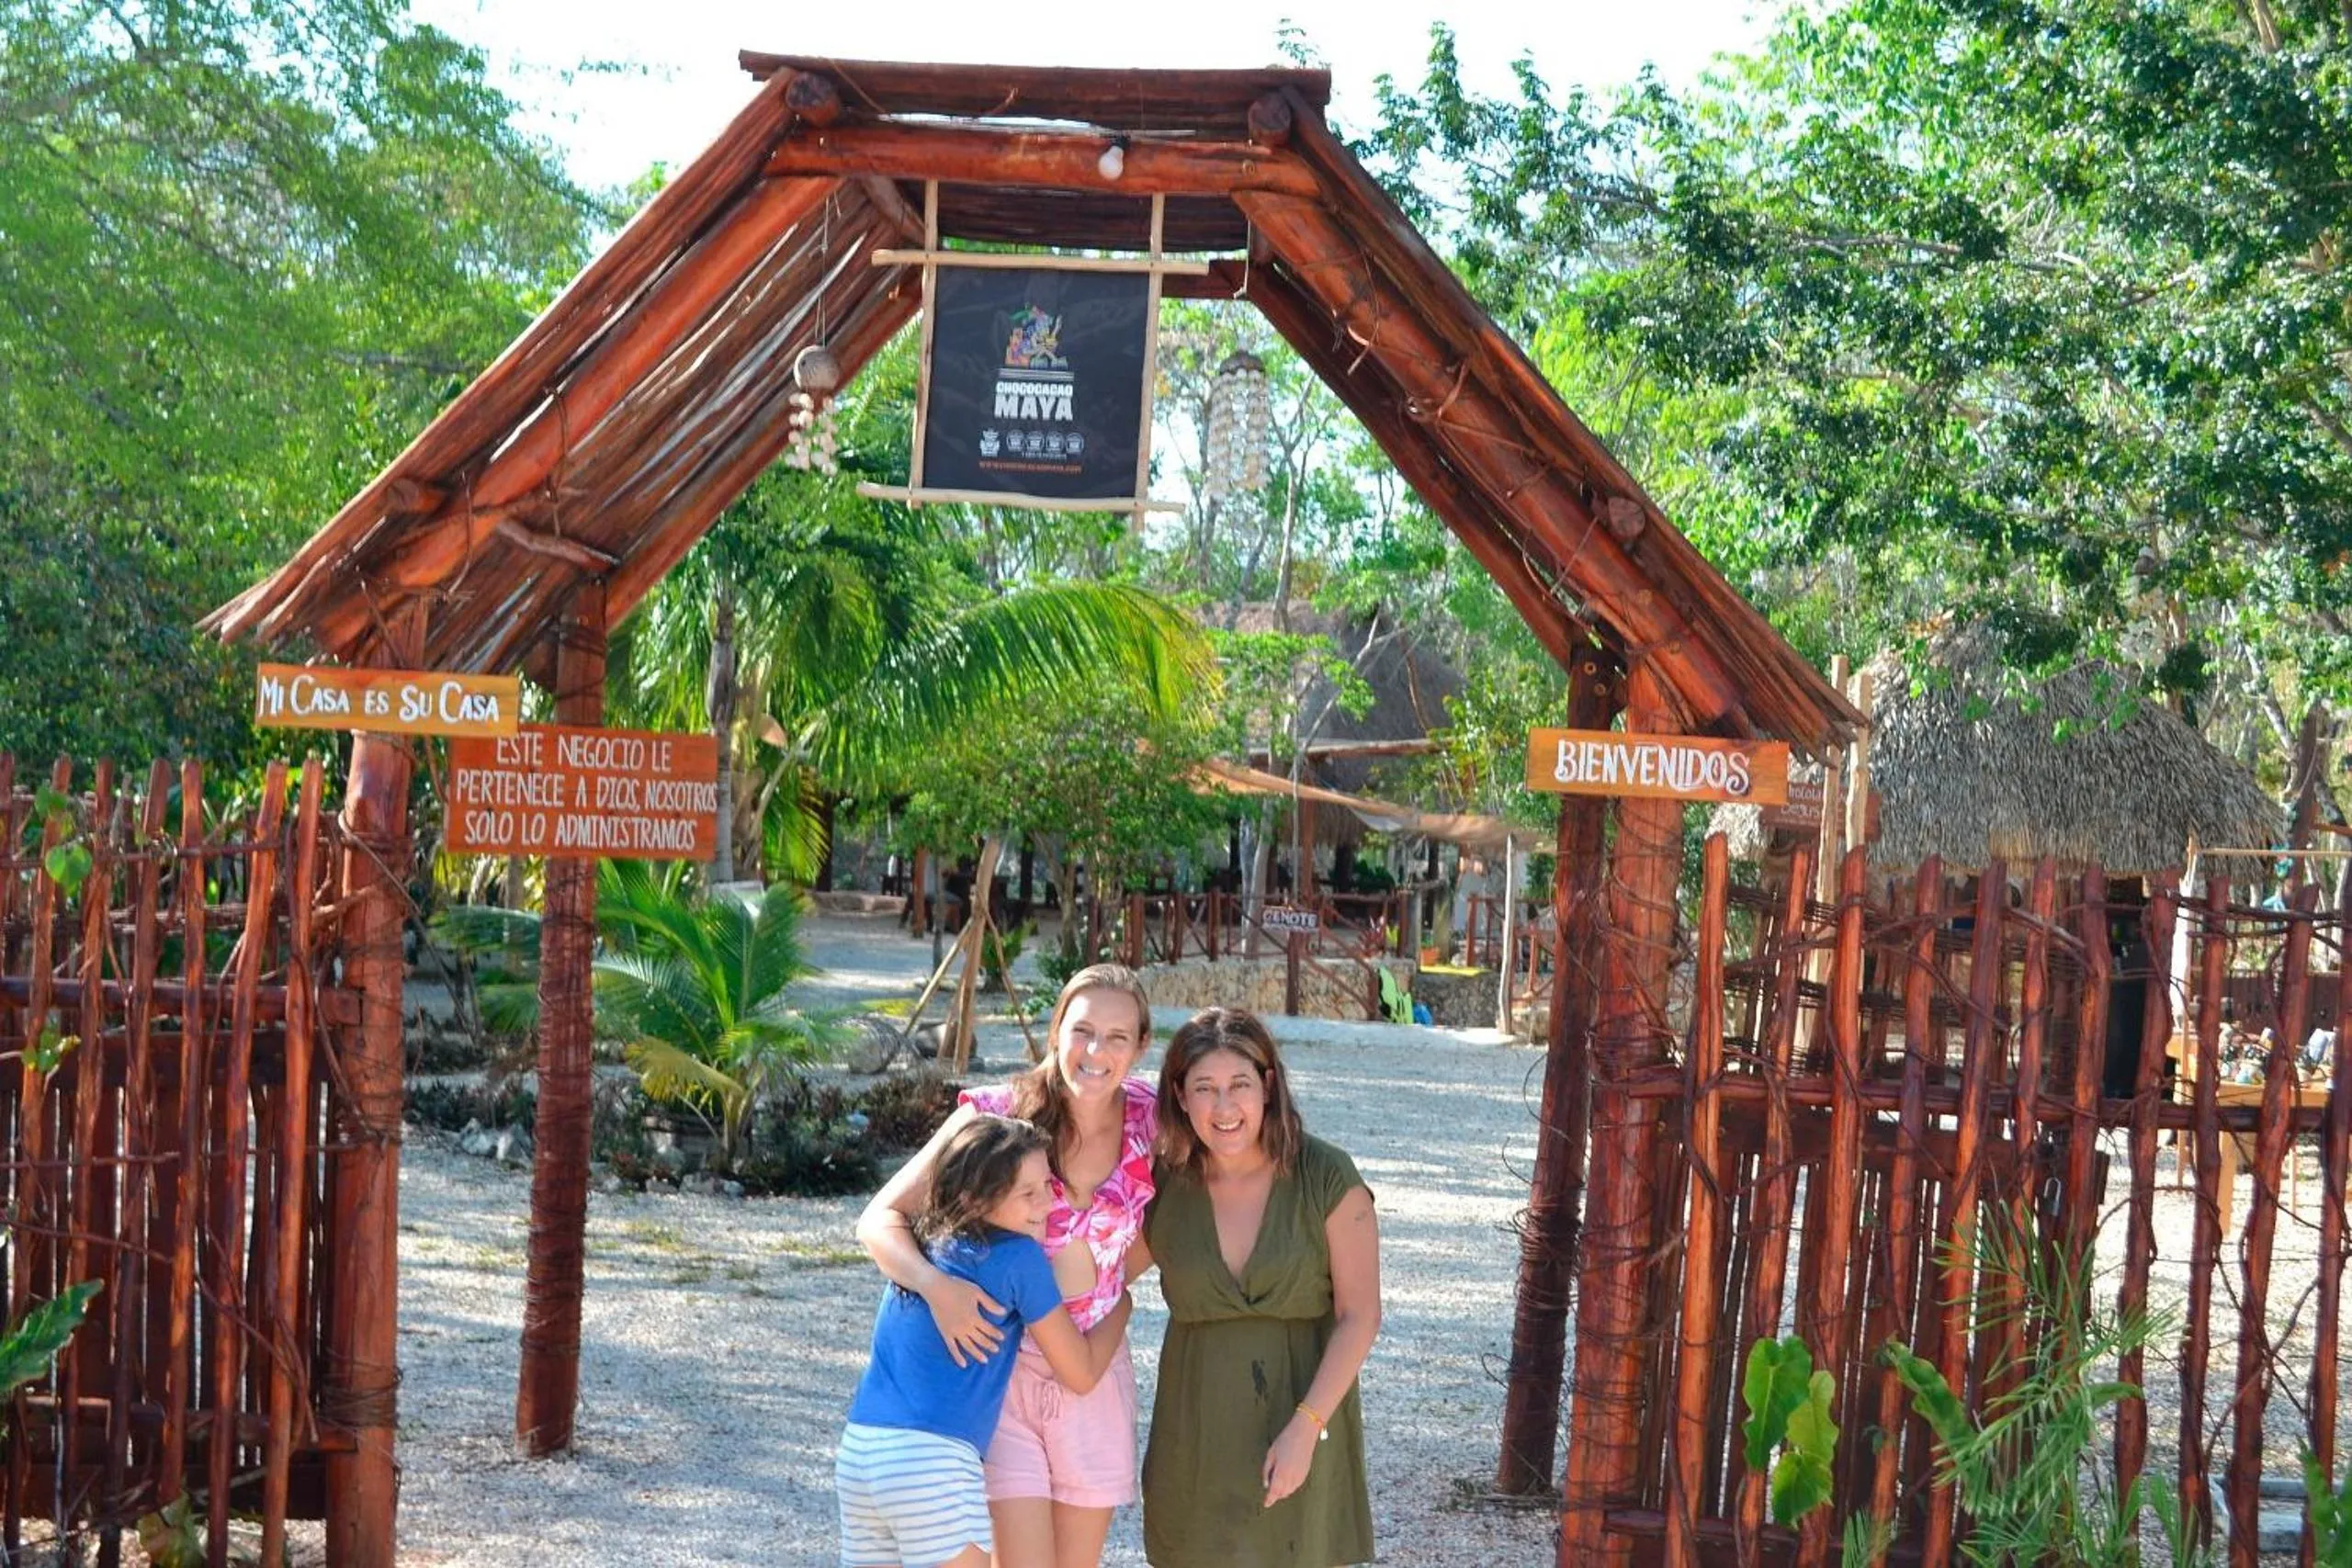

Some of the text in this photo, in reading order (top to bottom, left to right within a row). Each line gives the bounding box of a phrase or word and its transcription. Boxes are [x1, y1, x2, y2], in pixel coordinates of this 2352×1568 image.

[994, 394, 1073, 421] MAYA
[996, 381, 1073, 397] CHOCOCACAO
[259, 673, 499, 723] MI CASA ES SU CASA
[497, 731, 673, 772] ESTE NEGOCIO LE
[1554, 739, 1750, 795] BIENVENIDOS
[457, 768, 565, 807] PERTENECE
[575, 774, 587, 808] A
[645, 779, 718, 813] NOSOTROS
[464, 810, 697, 852] SOLO LO ADMINISTRAMOS
[1263, 908, 1317, 929] CENOTE
